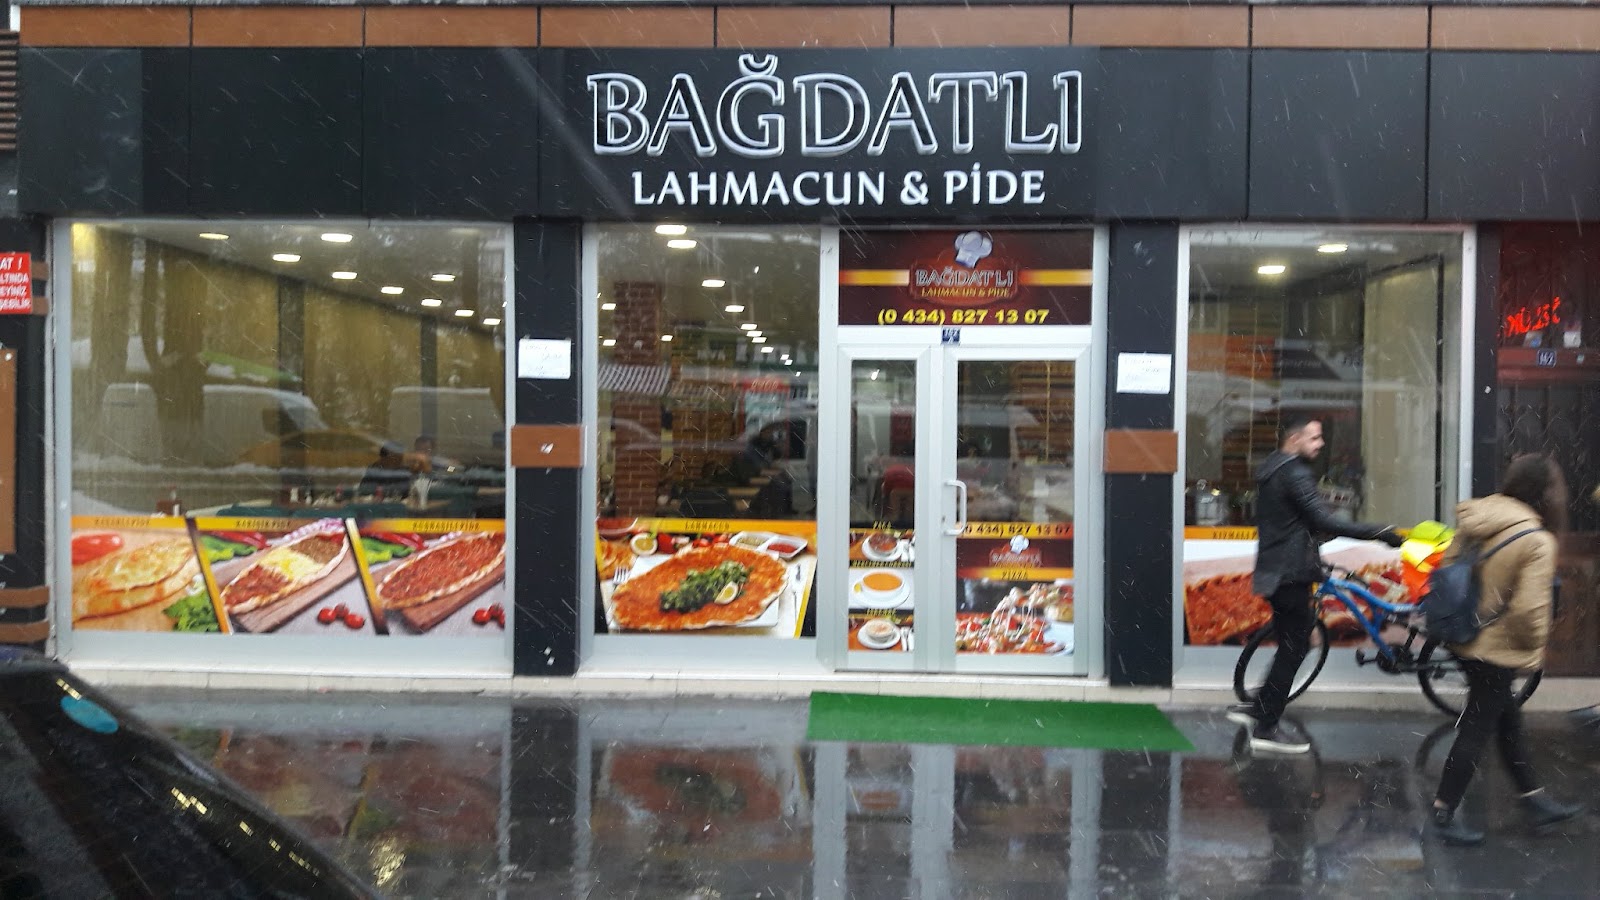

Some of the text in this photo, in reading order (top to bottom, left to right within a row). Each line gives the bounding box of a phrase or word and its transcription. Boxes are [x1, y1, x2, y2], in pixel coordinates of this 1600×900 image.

[587, 54, 1082, 157] BAĞDATLI
[632, 162, 1045, 206] LAHMACUN & PİDE
[915, 265, 1014, 287] BAĞDATLI
[921, 287, 976, 298] LAHMACUN
[878, 309, 1050, 326] (0 434) 827 13 07
